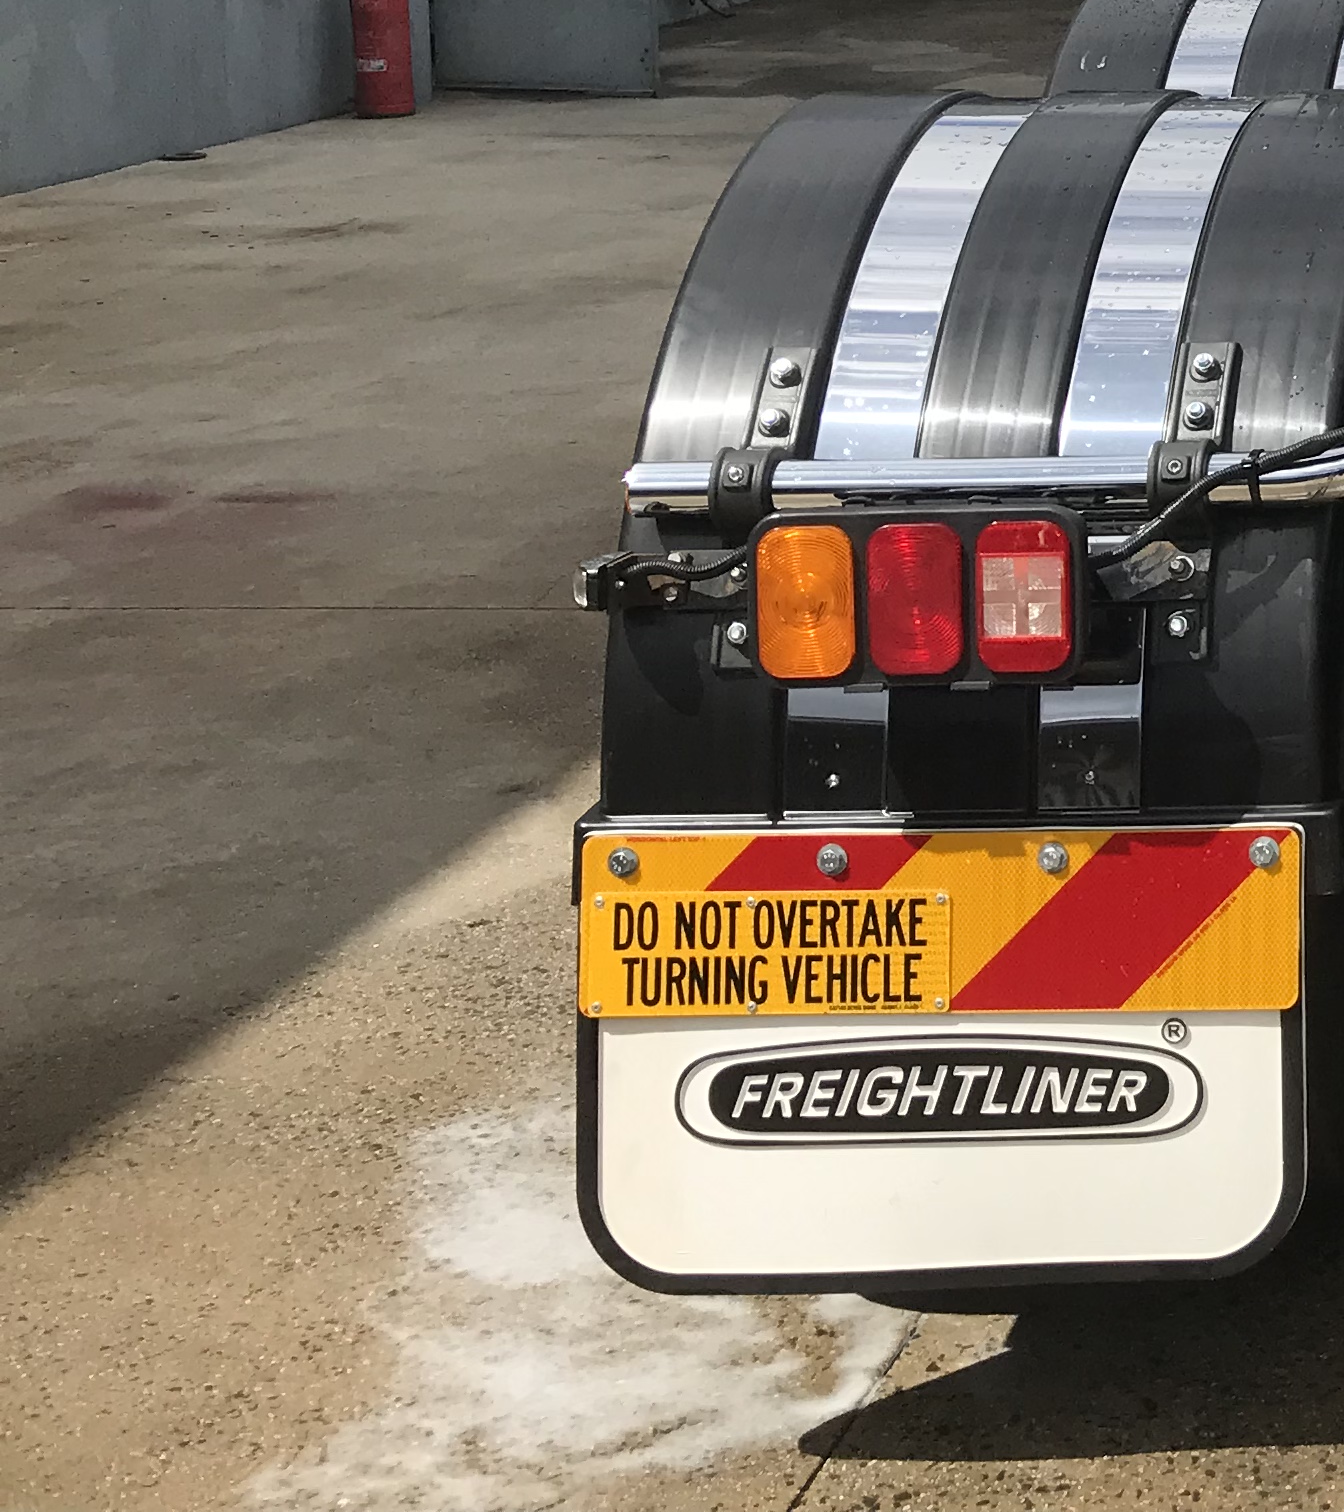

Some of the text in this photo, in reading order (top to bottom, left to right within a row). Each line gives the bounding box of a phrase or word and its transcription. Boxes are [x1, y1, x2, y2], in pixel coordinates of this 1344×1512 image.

[614, 898, 928, 951] DO NOT OVERTAKE
[623, 954, 923, 1006] TURNING VEHICLE
[731, 1065, 1149, 1119] FREIGHTLINER
